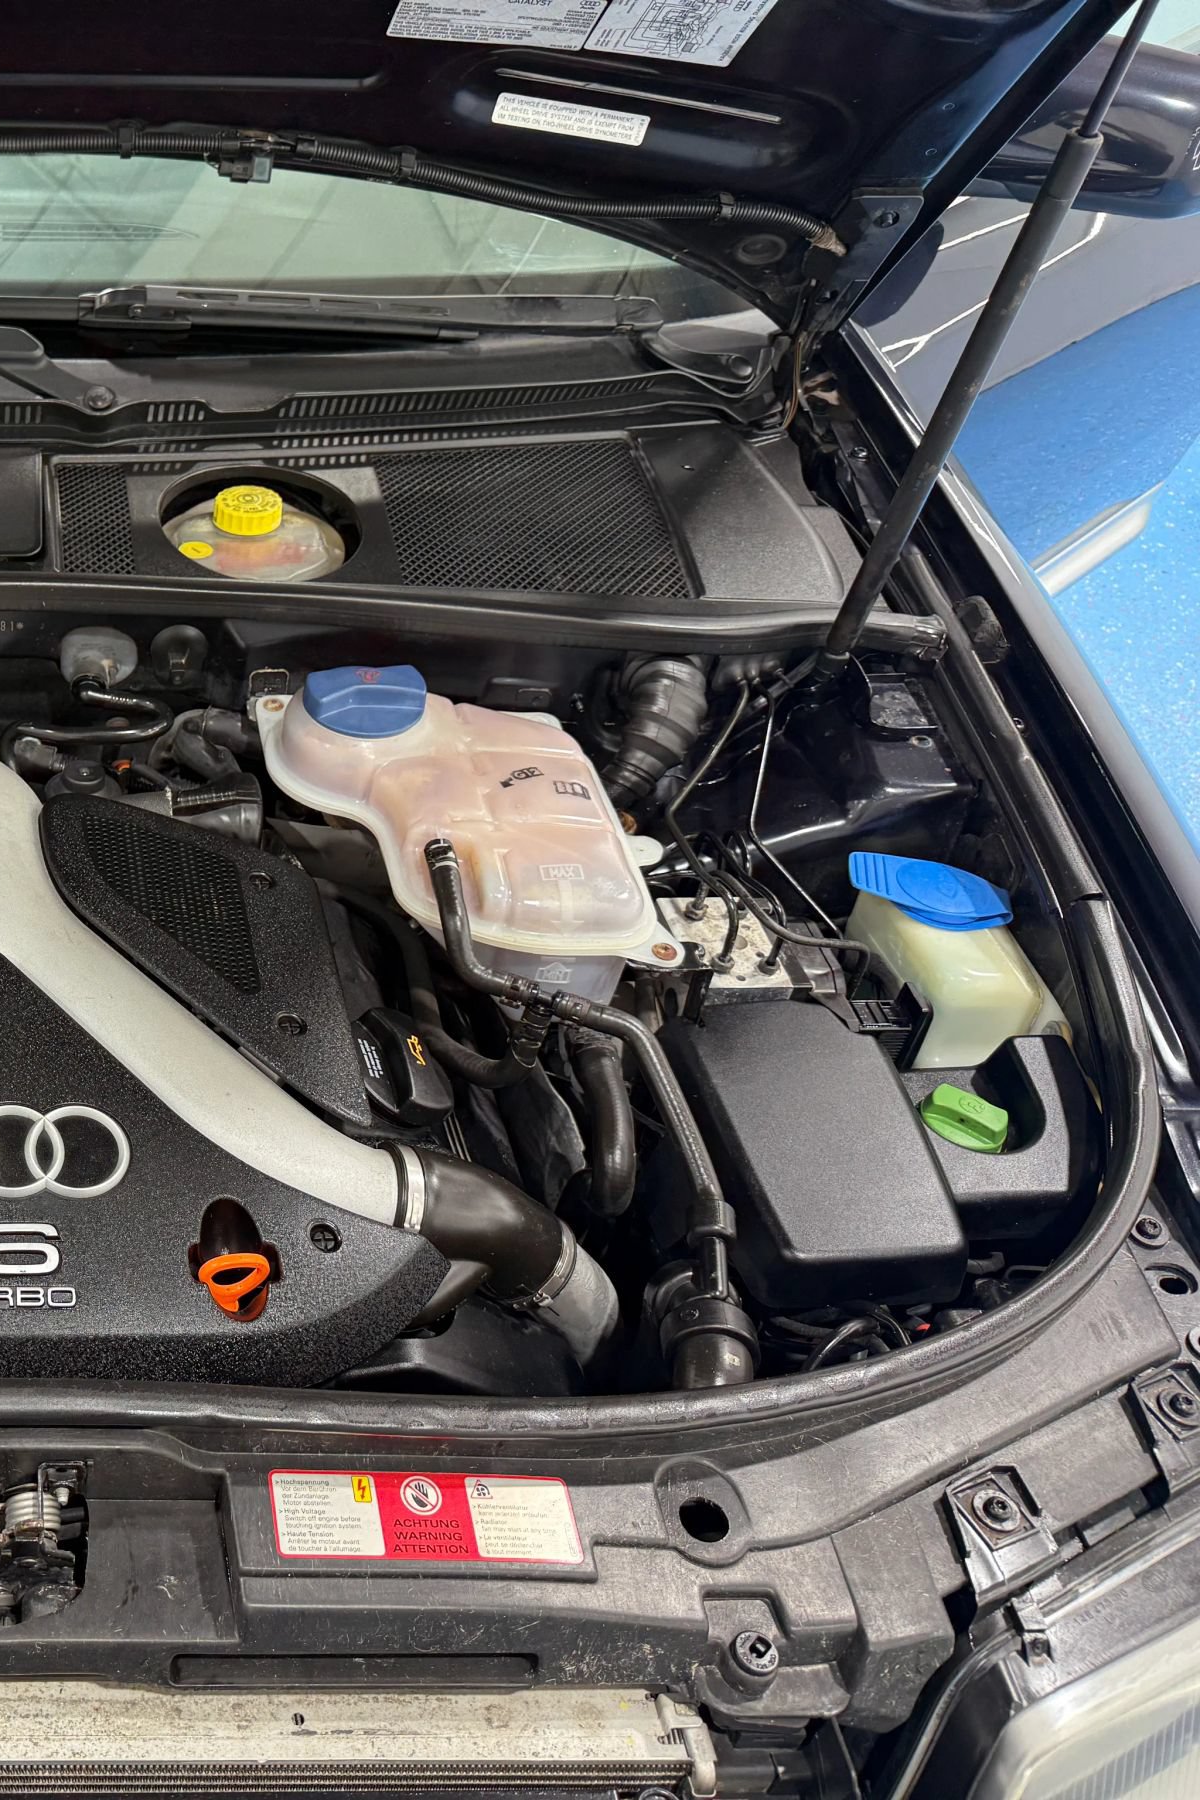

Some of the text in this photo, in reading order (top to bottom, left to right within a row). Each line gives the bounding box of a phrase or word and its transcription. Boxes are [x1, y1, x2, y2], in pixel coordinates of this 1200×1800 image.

[517, 99, 541, 108] VEHICLE
[600, 112, 634, 122] PERMANENT
[507, 114, 531, 124] TESTING
[576, 126, 593, 134] DRIVE
[511, 107, 530, 115] WHEEL
[532, 110, 548, 118] DRIVE
[551, 113, 572, 122] SYSTEM
[618, 123, 635, 132] FROM
[548, 866, 575, 878] MAX
[394, 1519, 460, 1529] ACHTUNG
[394, 1531, 463, 1541] WARNING
[393, 1543, 469, 1554] ATTENTION
